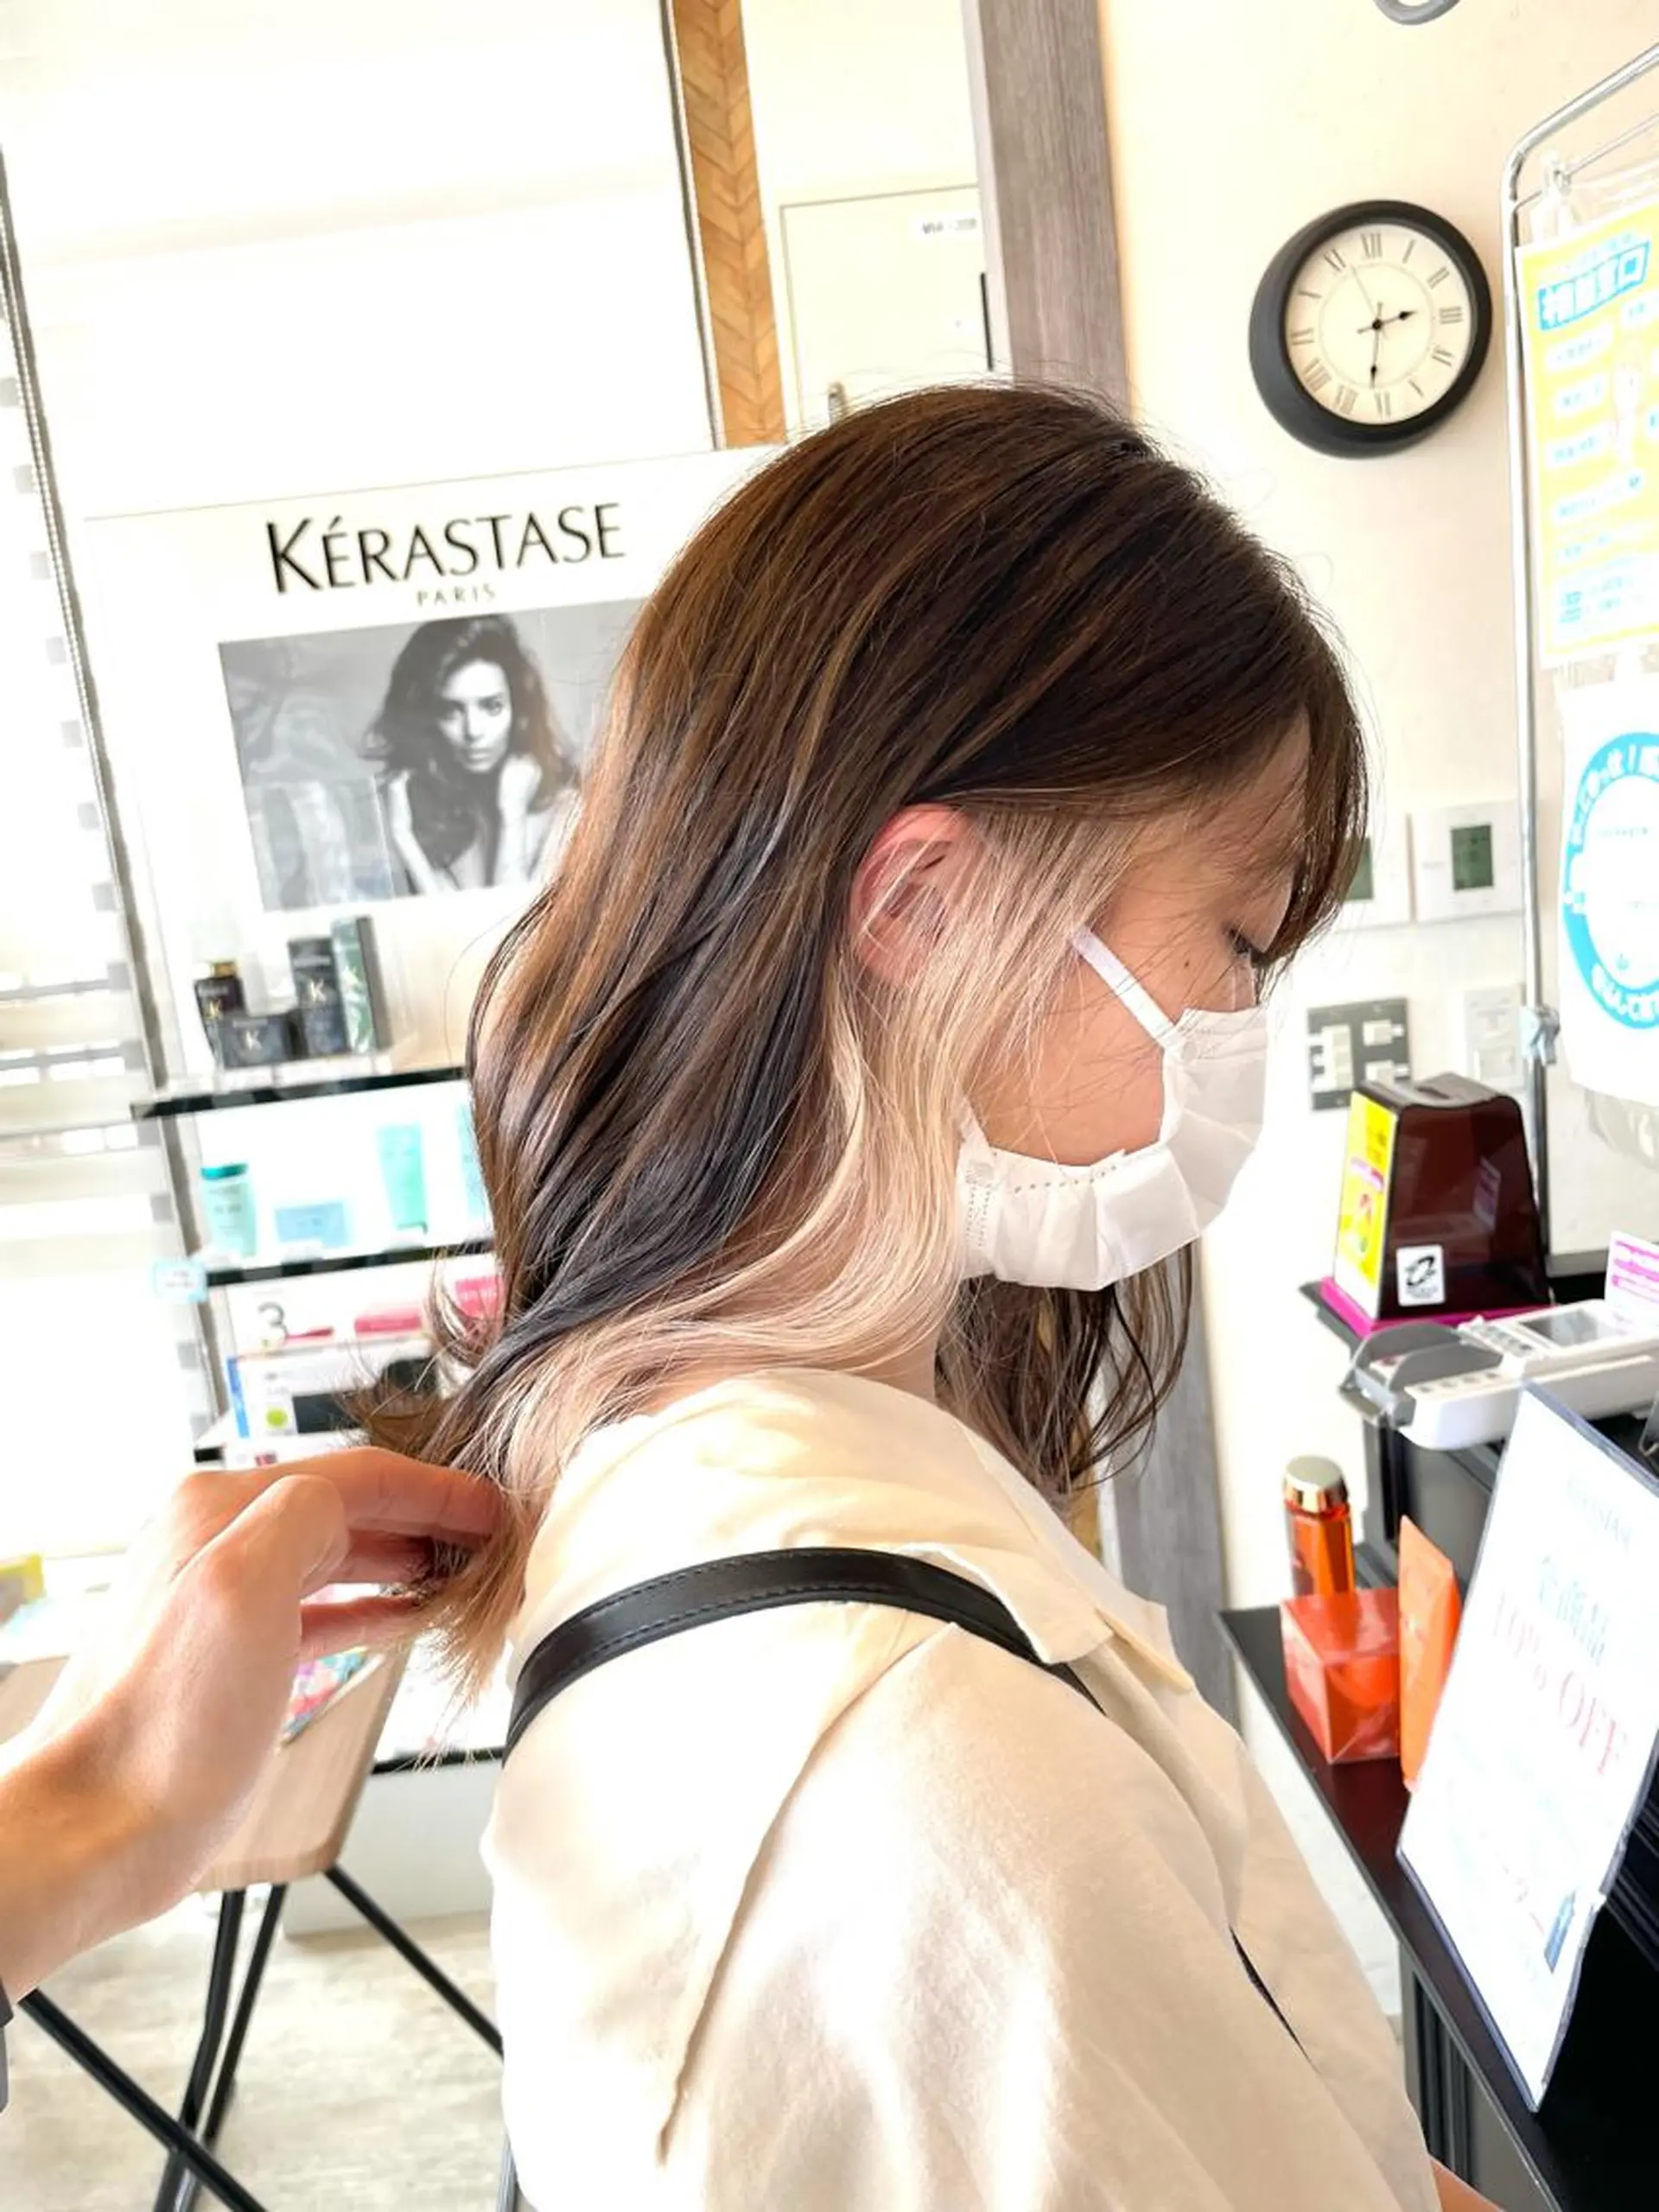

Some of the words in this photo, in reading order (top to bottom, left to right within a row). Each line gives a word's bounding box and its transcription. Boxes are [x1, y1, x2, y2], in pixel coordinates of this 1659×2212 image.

[266, 503, 625, 594] KÉRASTASE
[416, 584, 496, 607] PARIS
[1559, 1669, 1629, 1776] OFF
